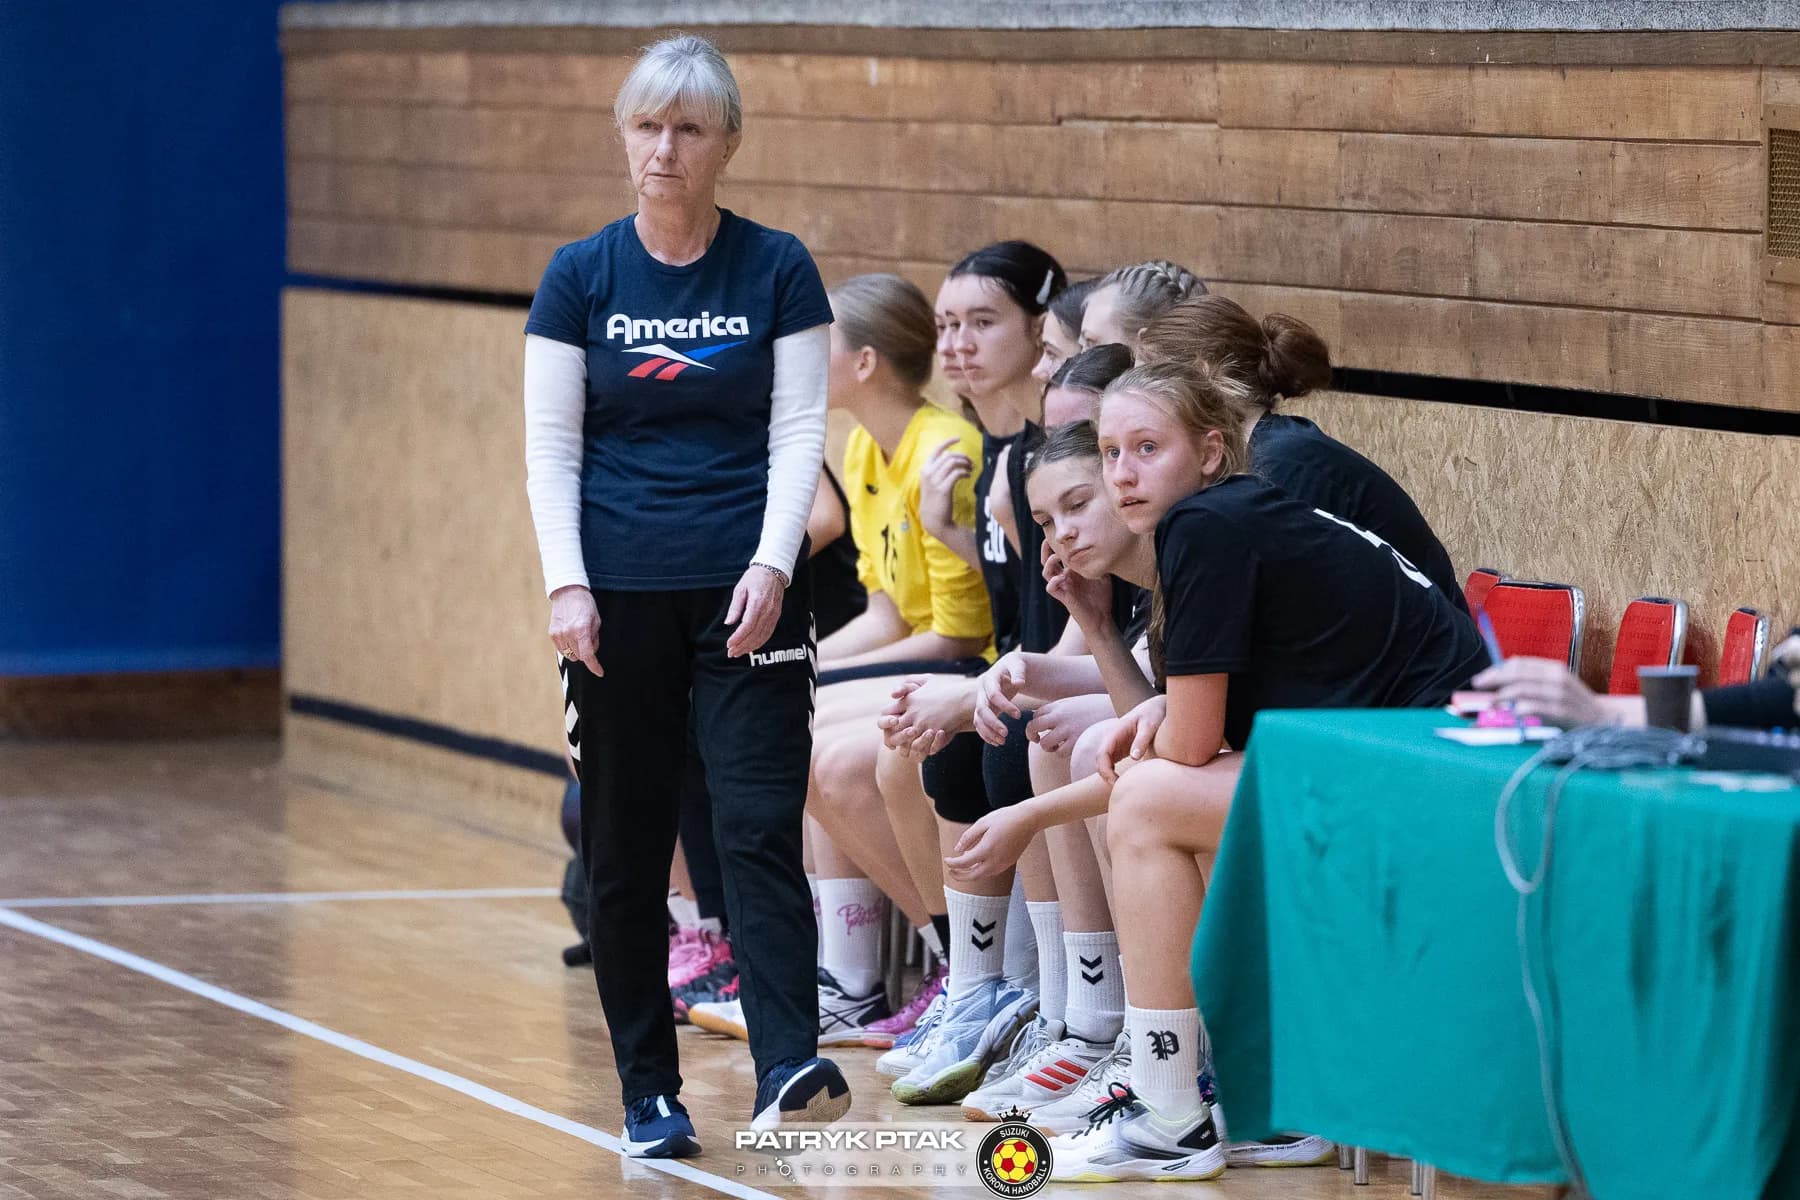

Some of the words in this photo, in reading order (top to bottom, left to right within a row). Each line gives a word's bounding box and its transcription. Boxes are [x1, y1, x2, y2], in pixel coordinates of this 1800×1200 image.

[606, 311, 750, 345] America
[749, 643, 807, 667] hummel
[1146, 1030, 1180, 1061] P
